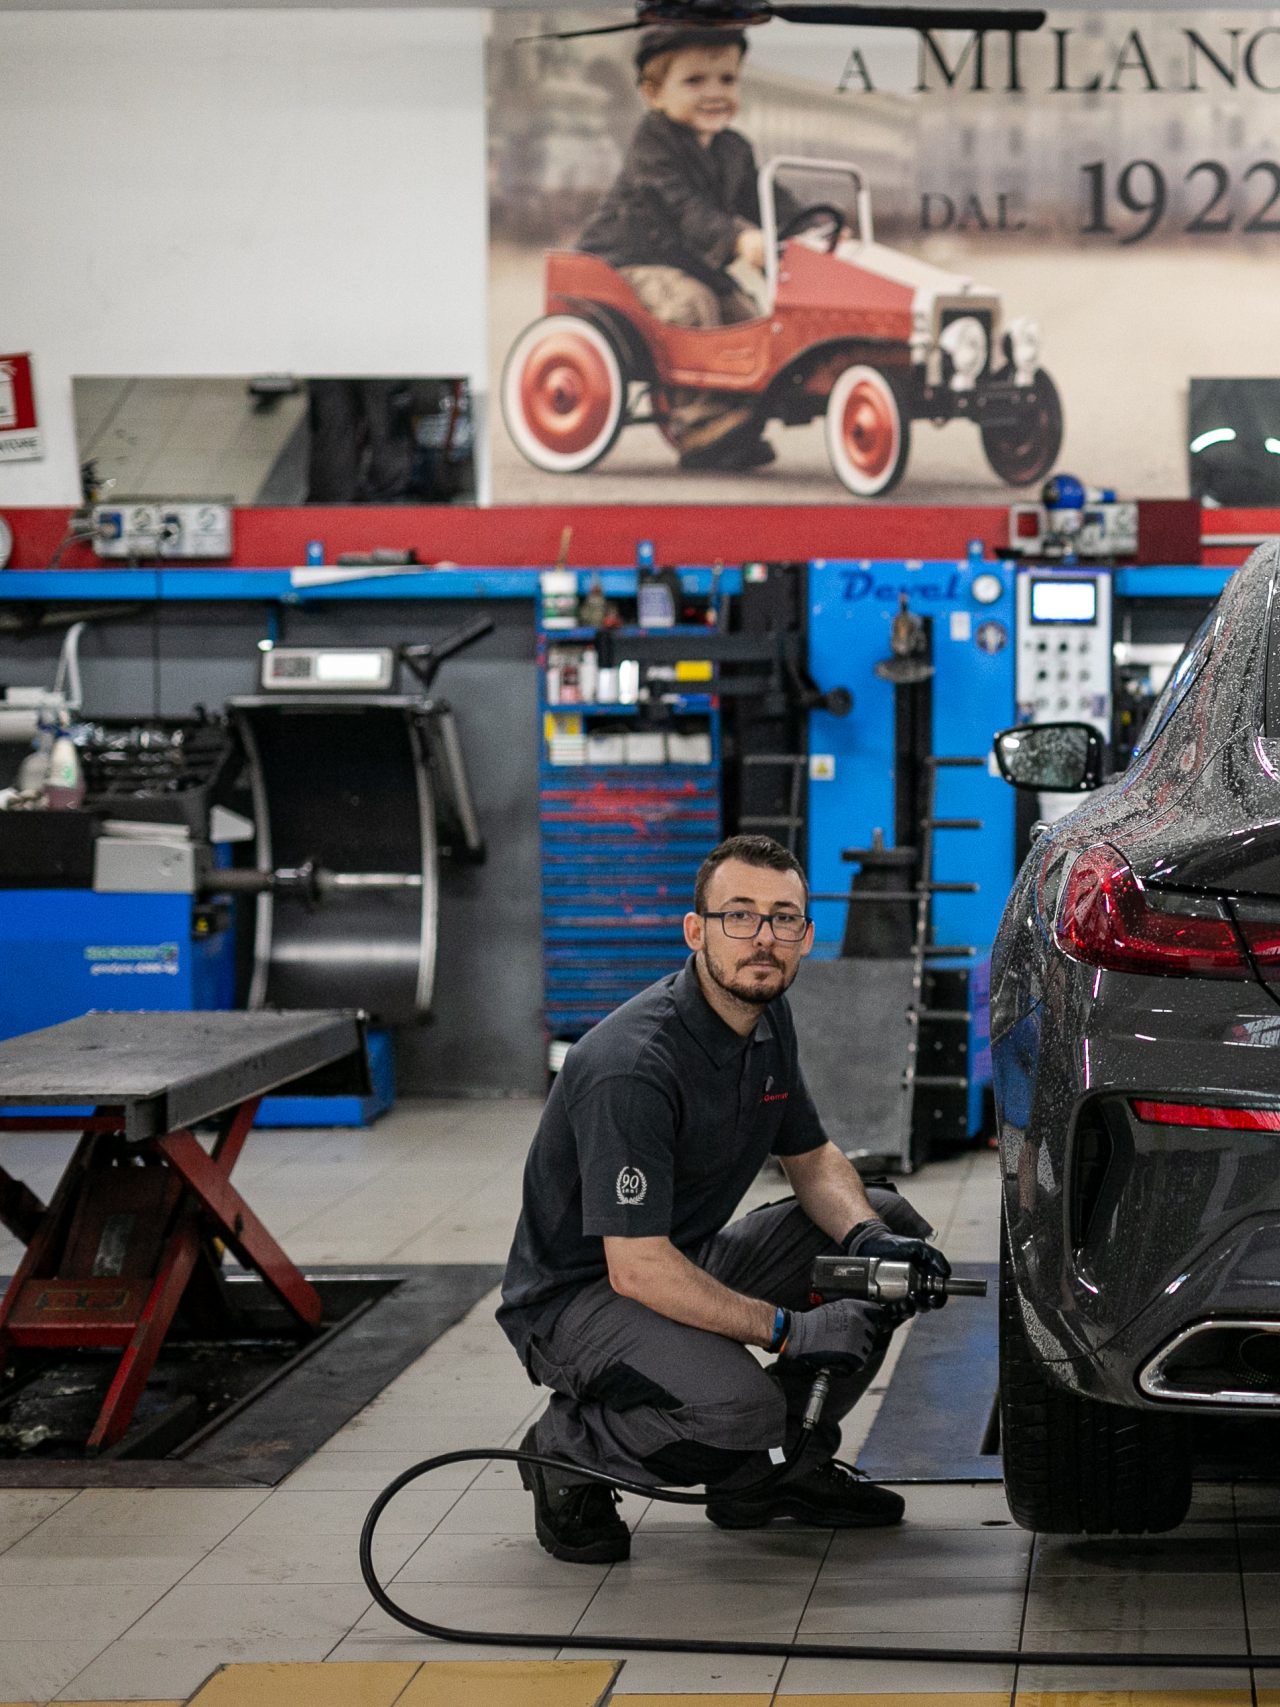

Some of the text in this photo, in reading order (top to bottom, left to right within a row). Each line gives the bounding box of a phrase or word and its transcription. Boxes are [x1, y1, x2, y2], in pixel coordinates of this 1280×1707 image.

[837, 48, 874, 93] A
[919, 192, 1025, 233] DAL
[621, 1174, 640, 1189] 90
